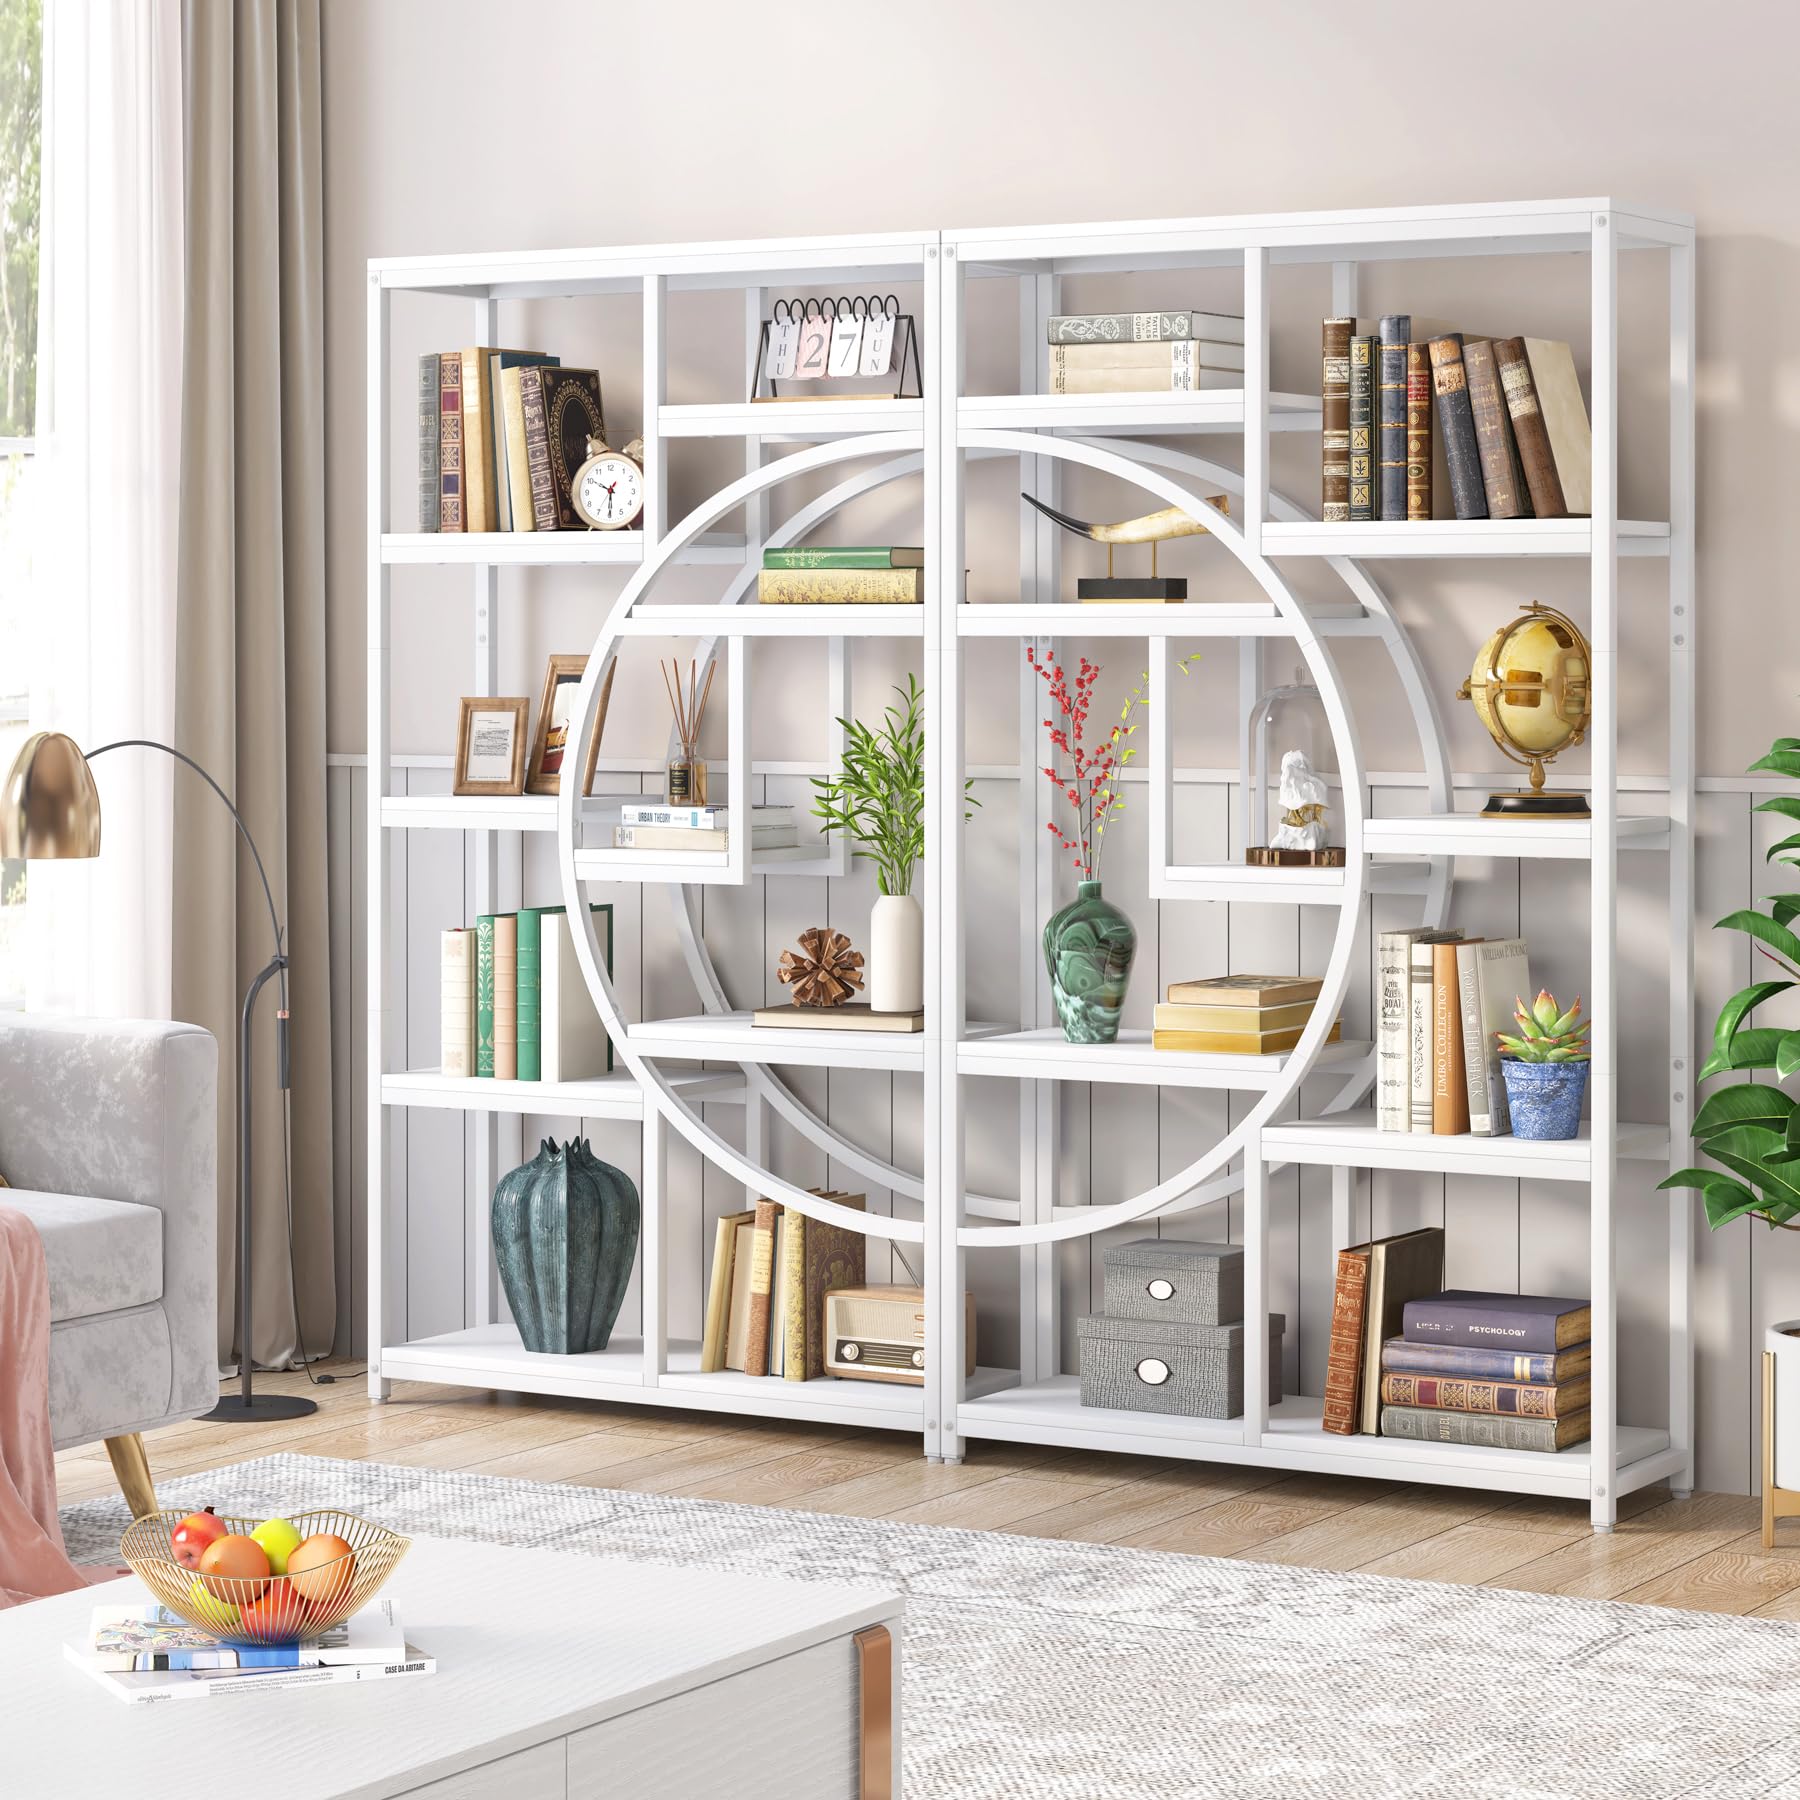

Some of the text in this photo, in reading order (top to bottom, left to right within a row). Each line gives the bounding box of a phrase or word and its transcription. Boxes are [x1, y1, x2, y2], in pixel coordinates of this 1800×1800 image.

[776, 325, 790, 376] THU
[869, 320, 885, 372] JUN
[638, 811, 653, 823] URBAN
[654, 812, 671, 824] THEORY
[1463, 967, 1477, 1014] YOUNG
[1436, 984, 1449, 1097] JUMBO COLLECTION
[1465, 1026, 1485, 1097] THE SHACK
[1468, 1325, 1526, 1337] PSYCHOLOGY
[384, 1662, 426, 1674] CASE DA ABITARE
